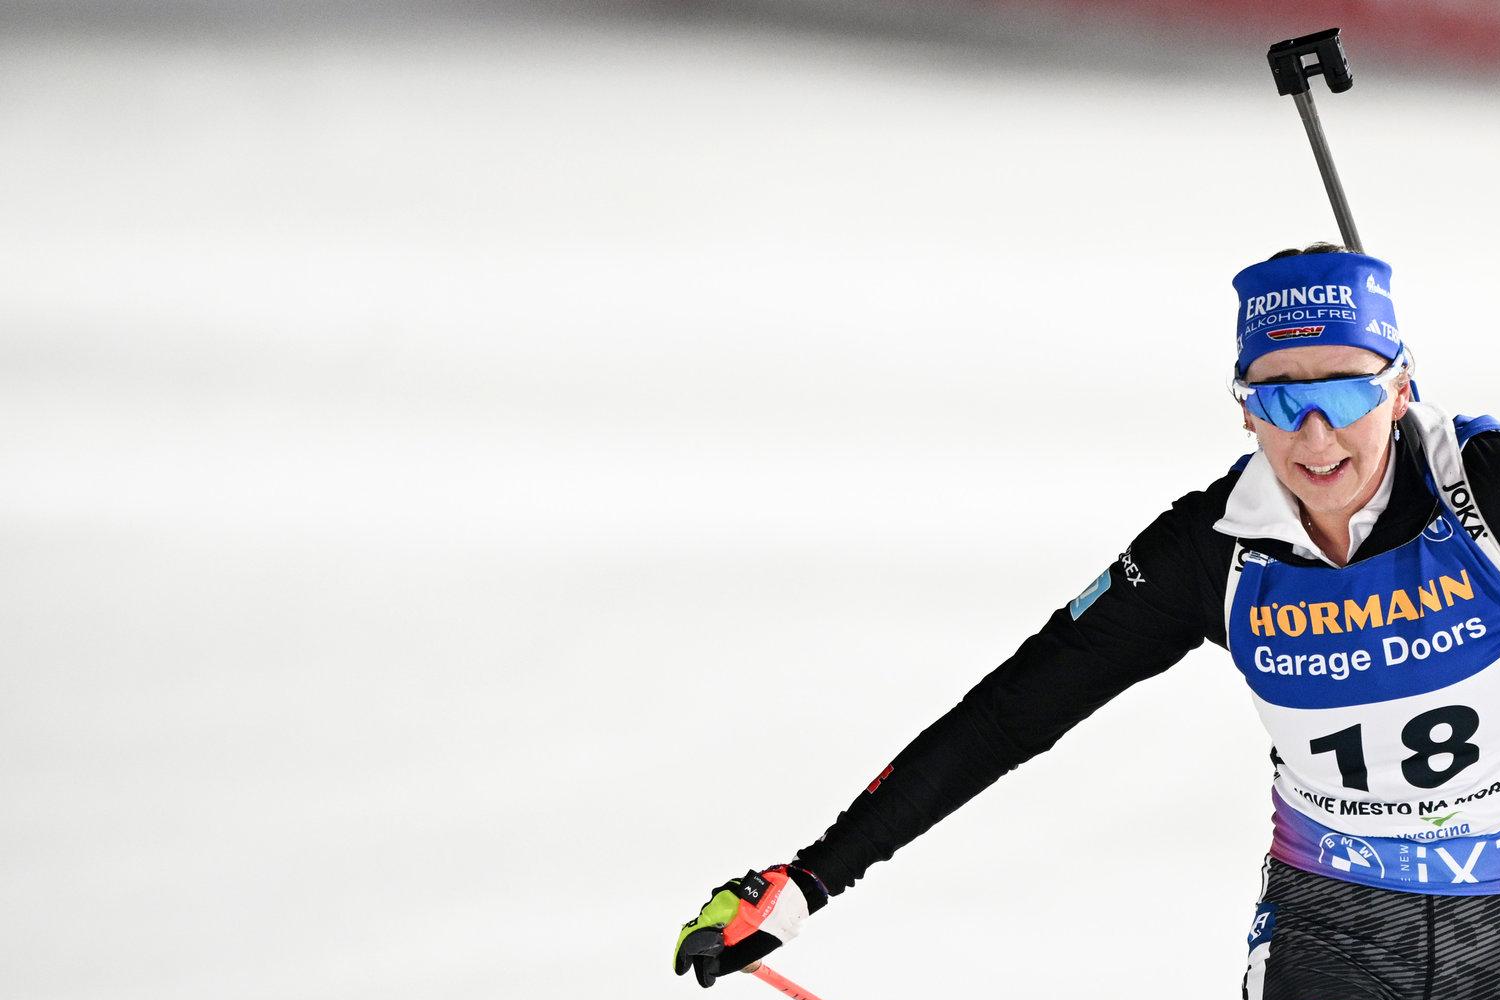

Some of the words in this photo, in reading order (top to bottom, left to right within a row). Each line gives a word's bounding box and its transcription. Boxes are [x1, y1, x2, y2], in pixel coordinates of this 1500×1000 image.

[1246, 284, 1357, 321] ERDINGER
[1245, 308, 1357, 335] ALKOHOLFREI
[1250, 569, 1475, 637] HÖRMANN
[1254, 645, 1372, 681] Garage
[1382, 616, 1487, 667] Doors
[1309, 704, 1480, 793] 18
[1294, 787, 1337, 815] OVE
[1419, 799, 1449, 816] NA
[1324, 836, 1373, 859] BMW
[1400, 844, 1410, 872] NEW
